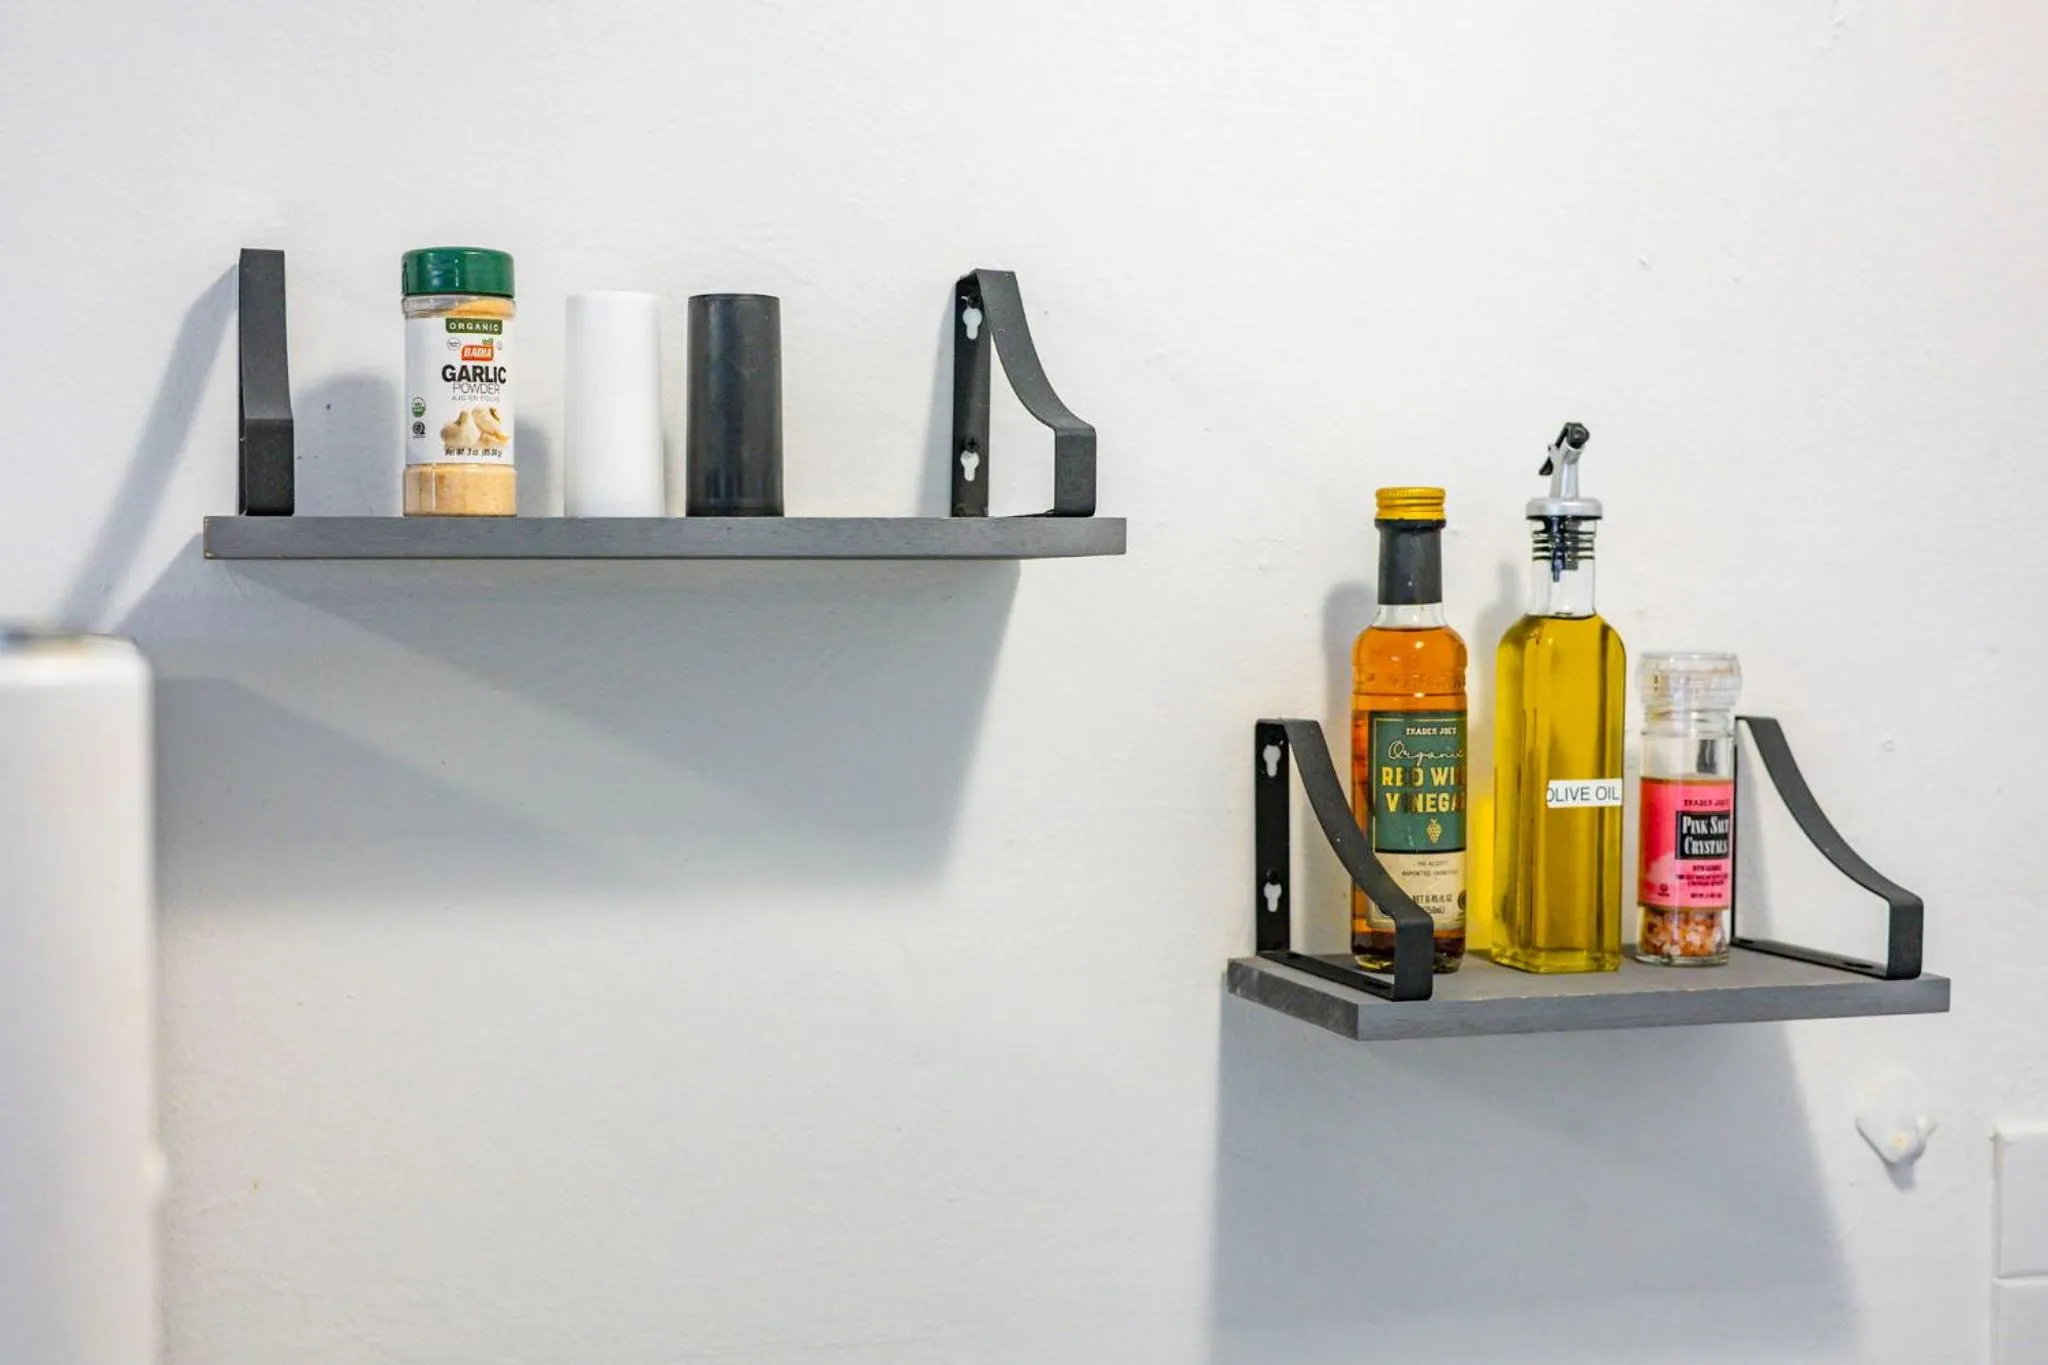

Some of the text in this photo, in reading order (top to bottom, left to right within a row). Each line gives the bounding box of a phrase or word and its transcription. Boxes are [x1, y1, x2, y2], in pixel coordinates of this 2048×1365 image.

[449, 322, 500, 332] ORGANIC
[463, 347, 492, 357] BADIA
[441, 364, 507, 384] GARLIC
[452, 382, 500, 395] POWDER
[1406, 727, 1437, 735] TRADER
[1595, 785, 1620, 801] OIL
[1682, 815, 1708, 835] PINK
